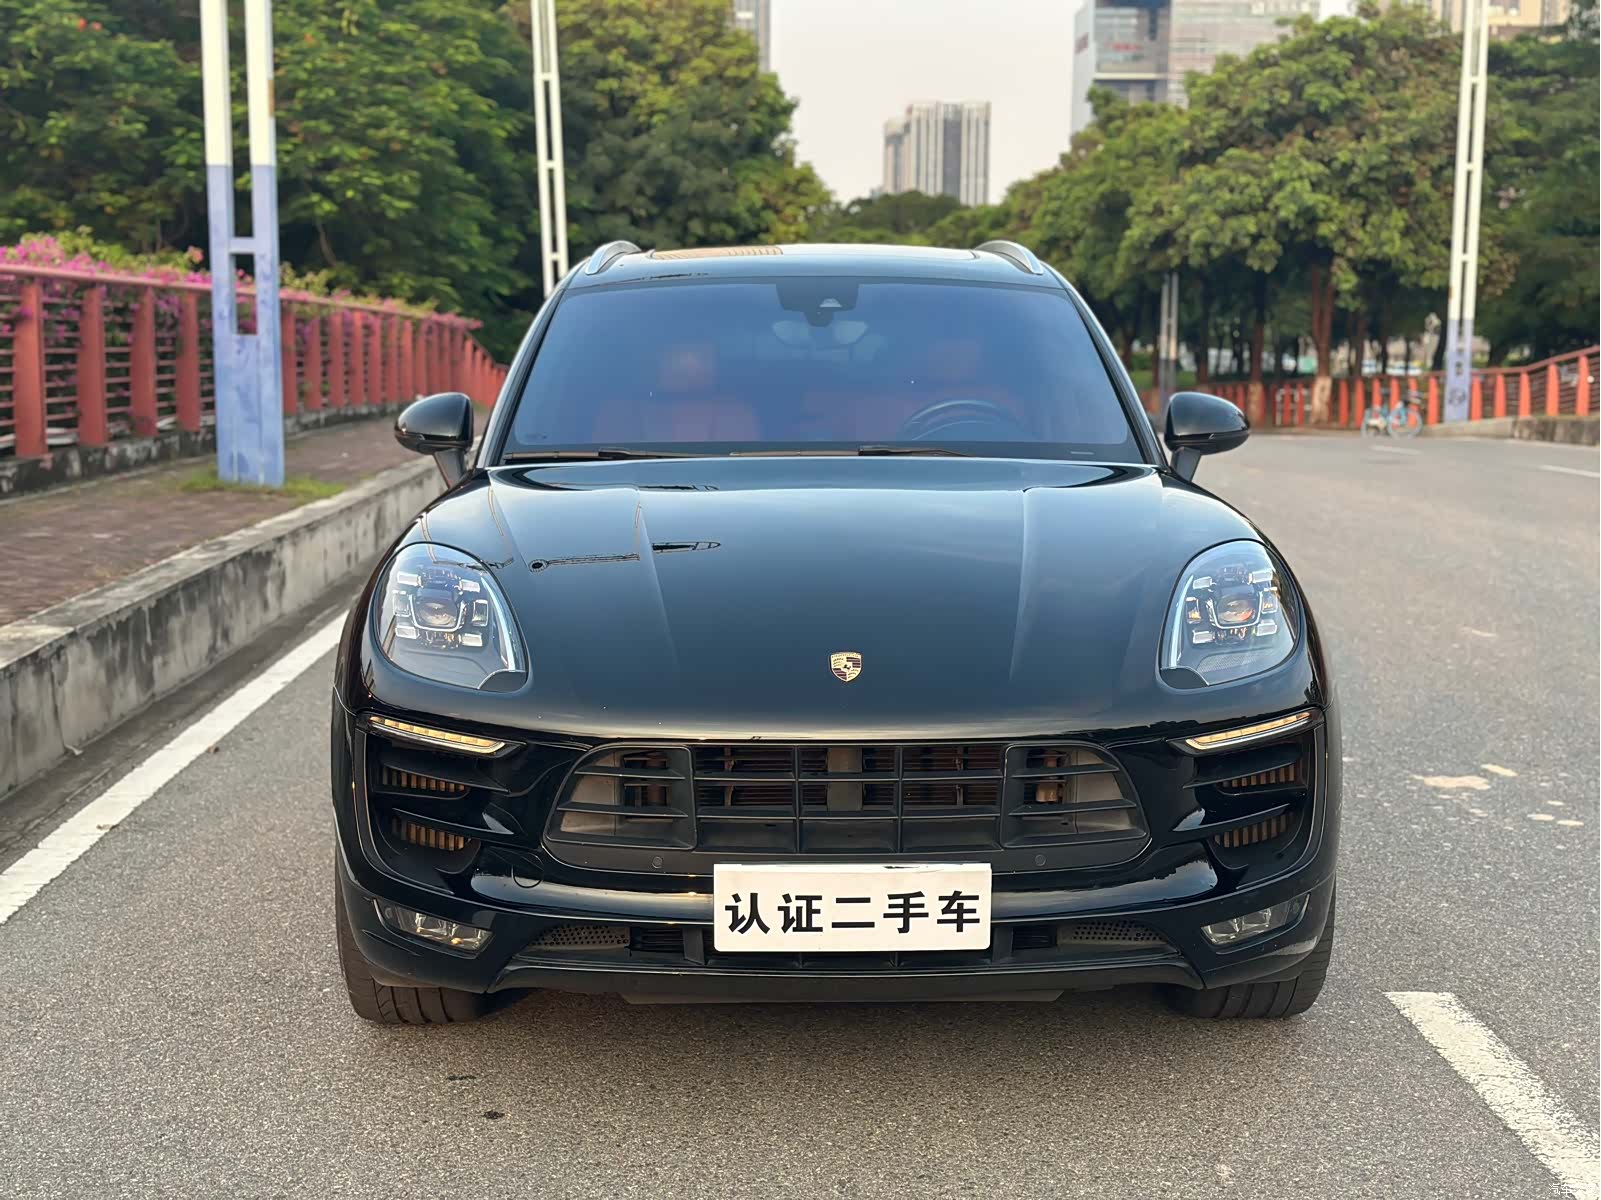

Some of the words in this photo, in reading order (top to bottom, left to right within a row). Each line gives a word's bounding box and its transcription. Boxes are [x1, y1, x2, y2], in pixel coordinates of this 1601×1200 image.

[725, 891, 980, 934] 认证二手车
